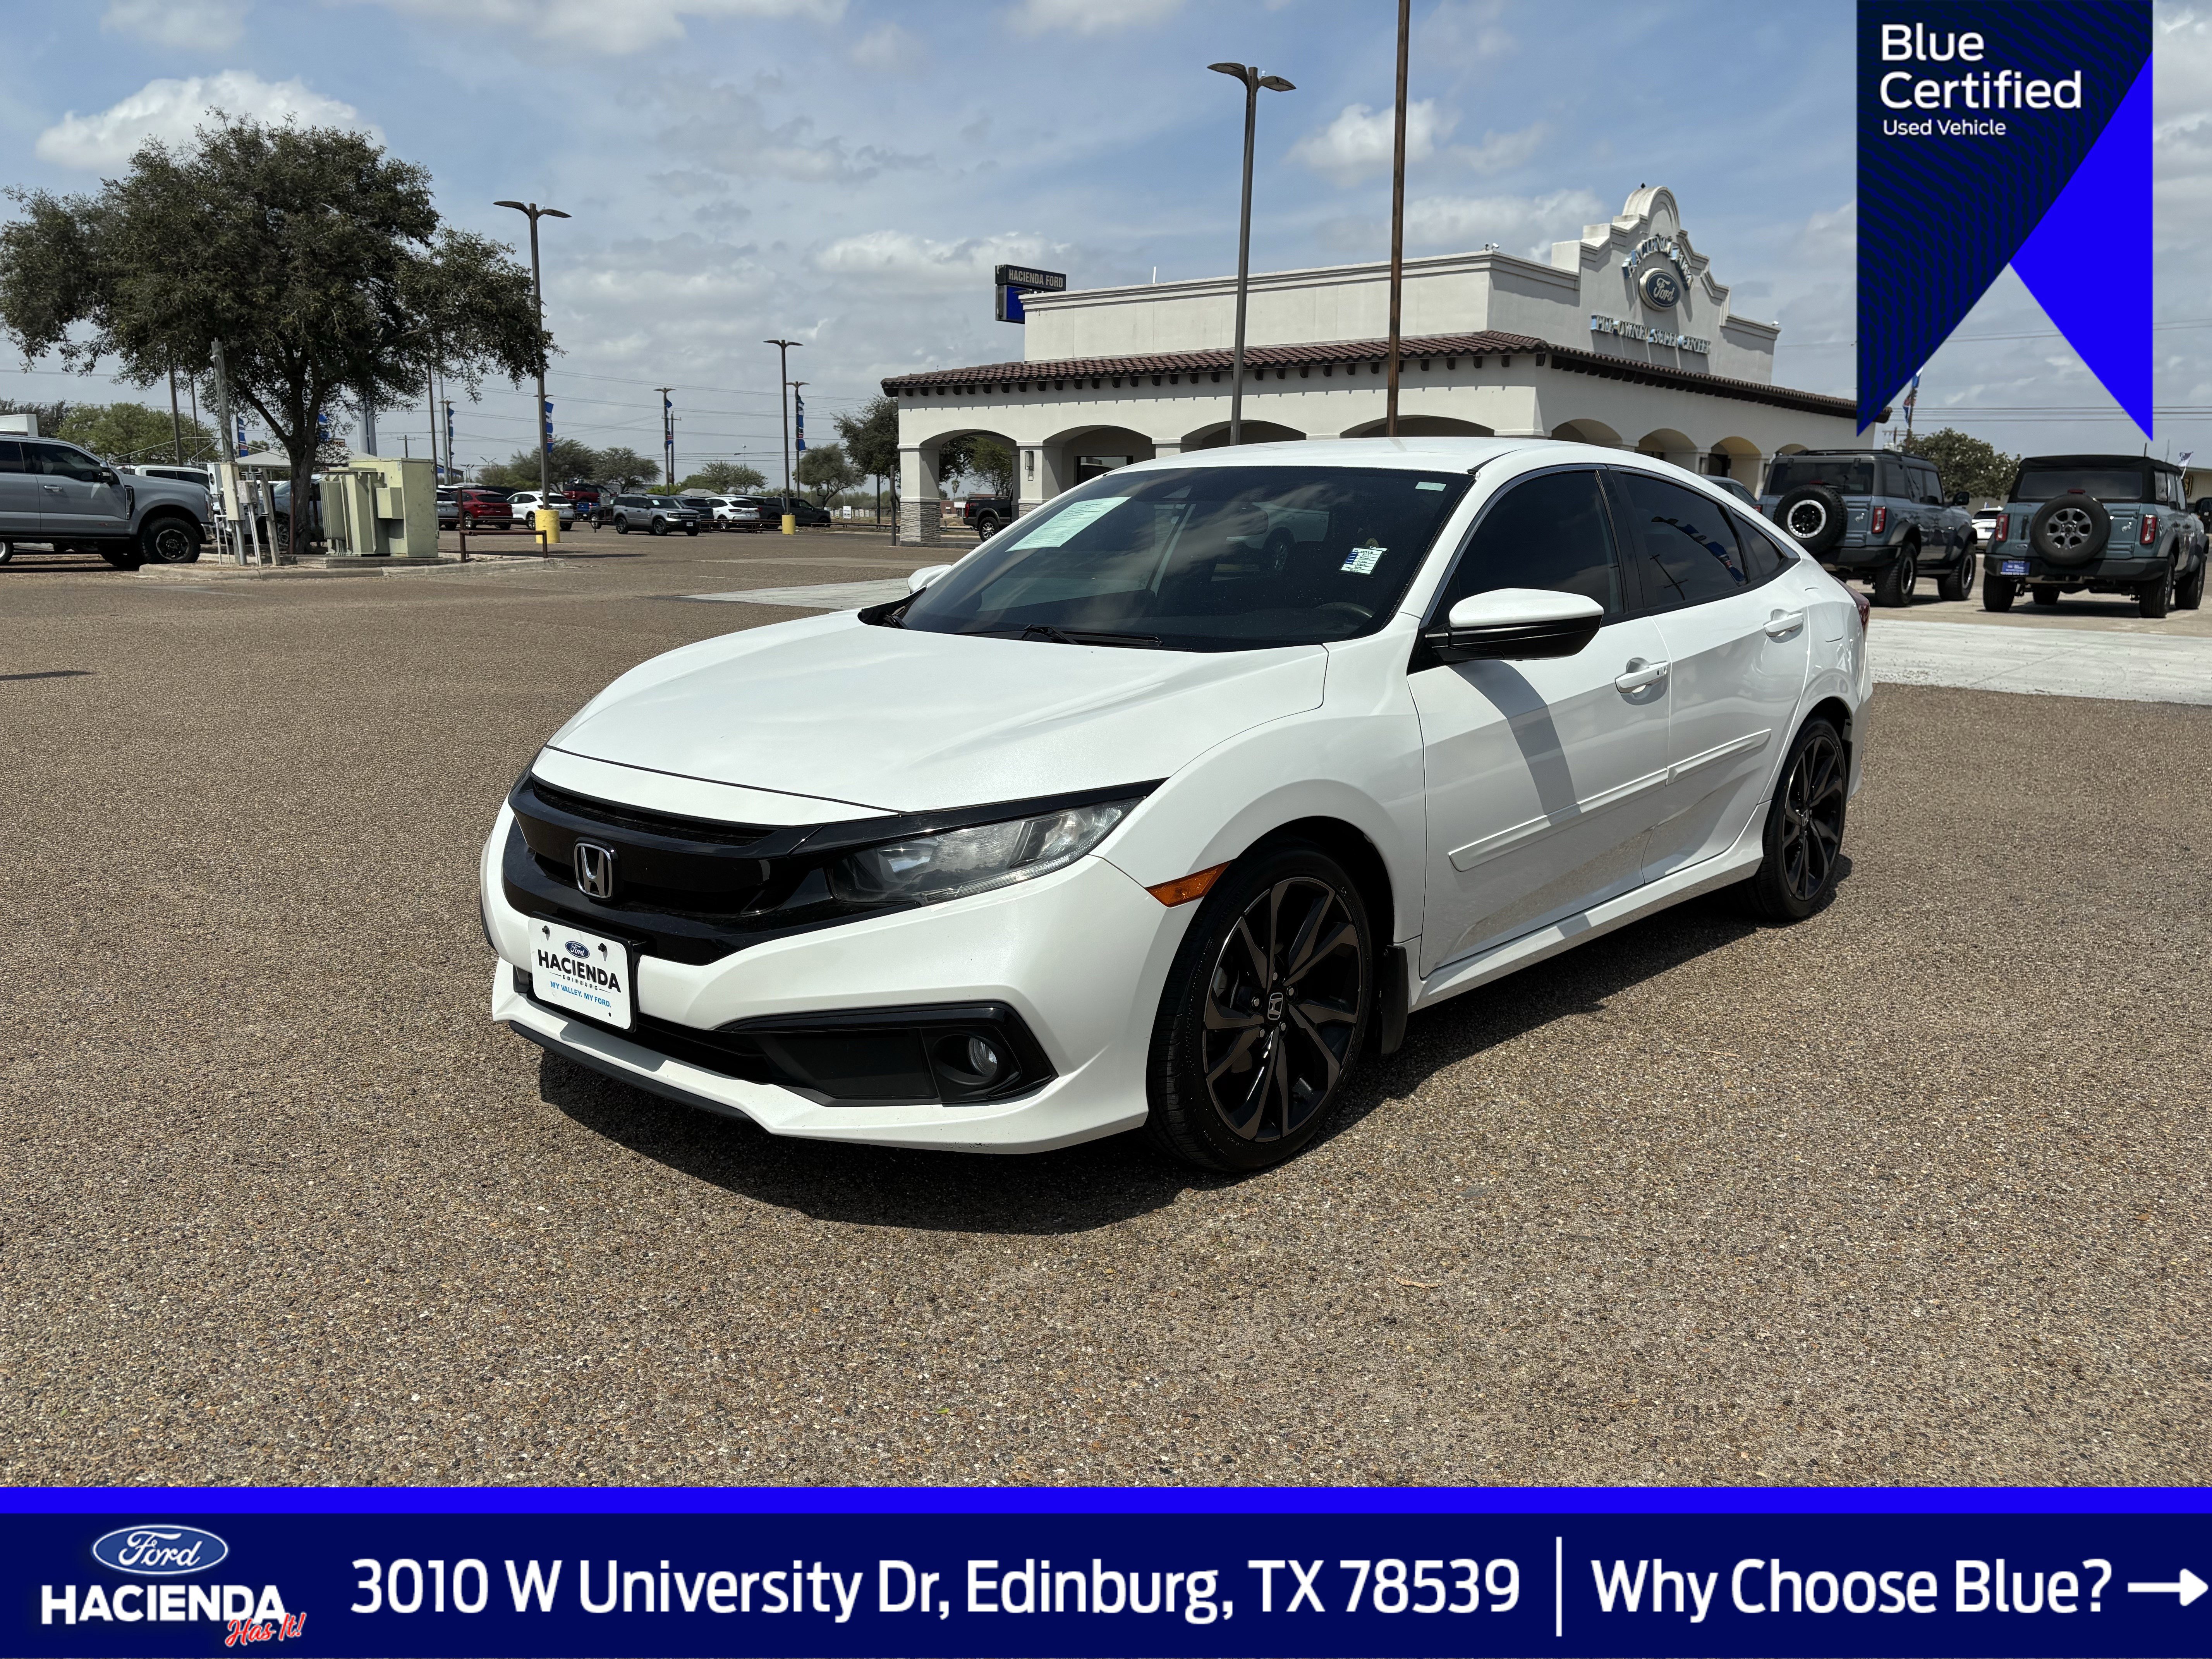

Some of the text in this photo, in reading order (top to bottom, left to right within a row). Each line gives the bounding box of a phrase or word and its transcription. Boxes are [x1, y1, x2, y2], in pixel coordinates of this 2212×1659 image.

[1009, 269, 1063, 288] HACIENDA FORD
[1653, 277, 1676, 302] Ford
[570, 943, 586, 957] Ford
[538, 949, 621, 993] HACIENDA
[563, 975, 598, 991] EDINBURG
[550, 981, 611, 1008] MY VALLEY. MY FORD.
